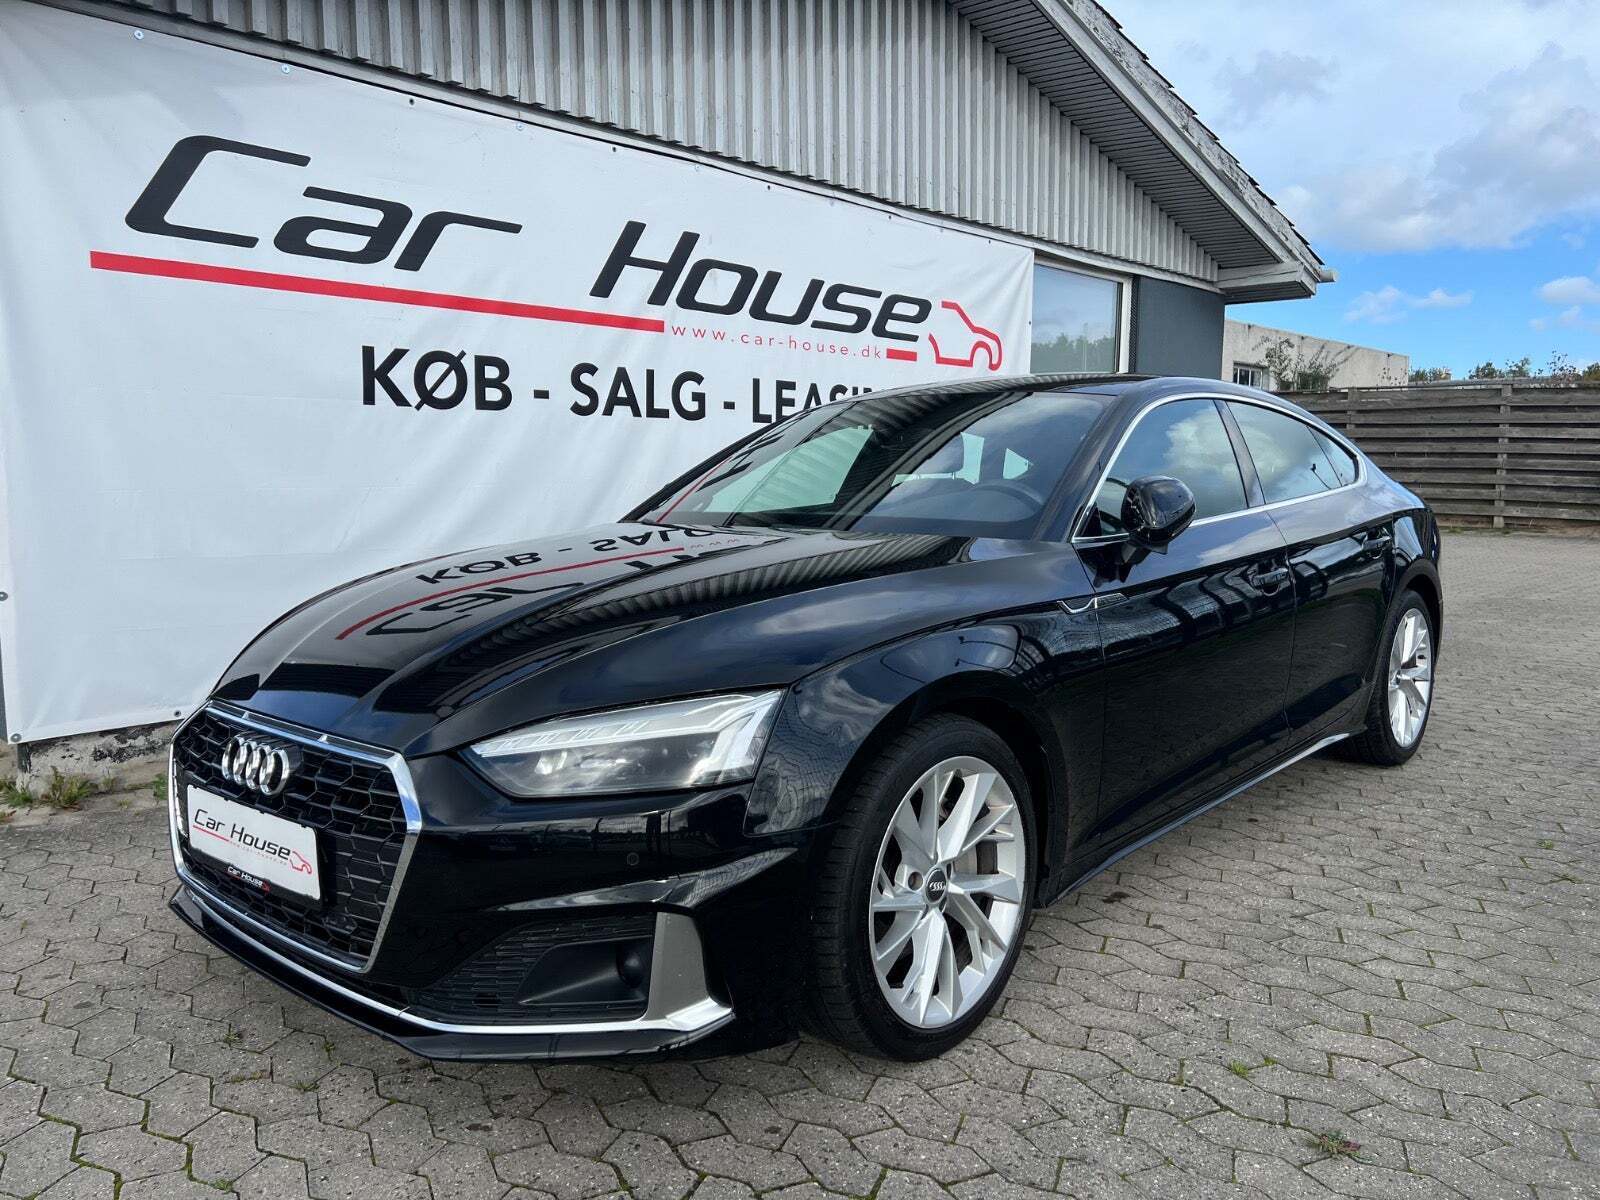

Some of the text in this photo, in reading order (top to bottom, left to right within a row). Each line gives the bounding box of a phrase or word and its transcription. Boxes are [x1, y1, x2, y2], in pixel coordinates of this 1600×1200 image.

[125, 135, 932, 342] Car House
[671, 326, 881, 359] www.car-house.dk
[361, 345, 512, 411] KØB
[570, 362, 706, 422] SALG
[194, 808, 225, 832] Car
[230, 823, 291, 861] House
